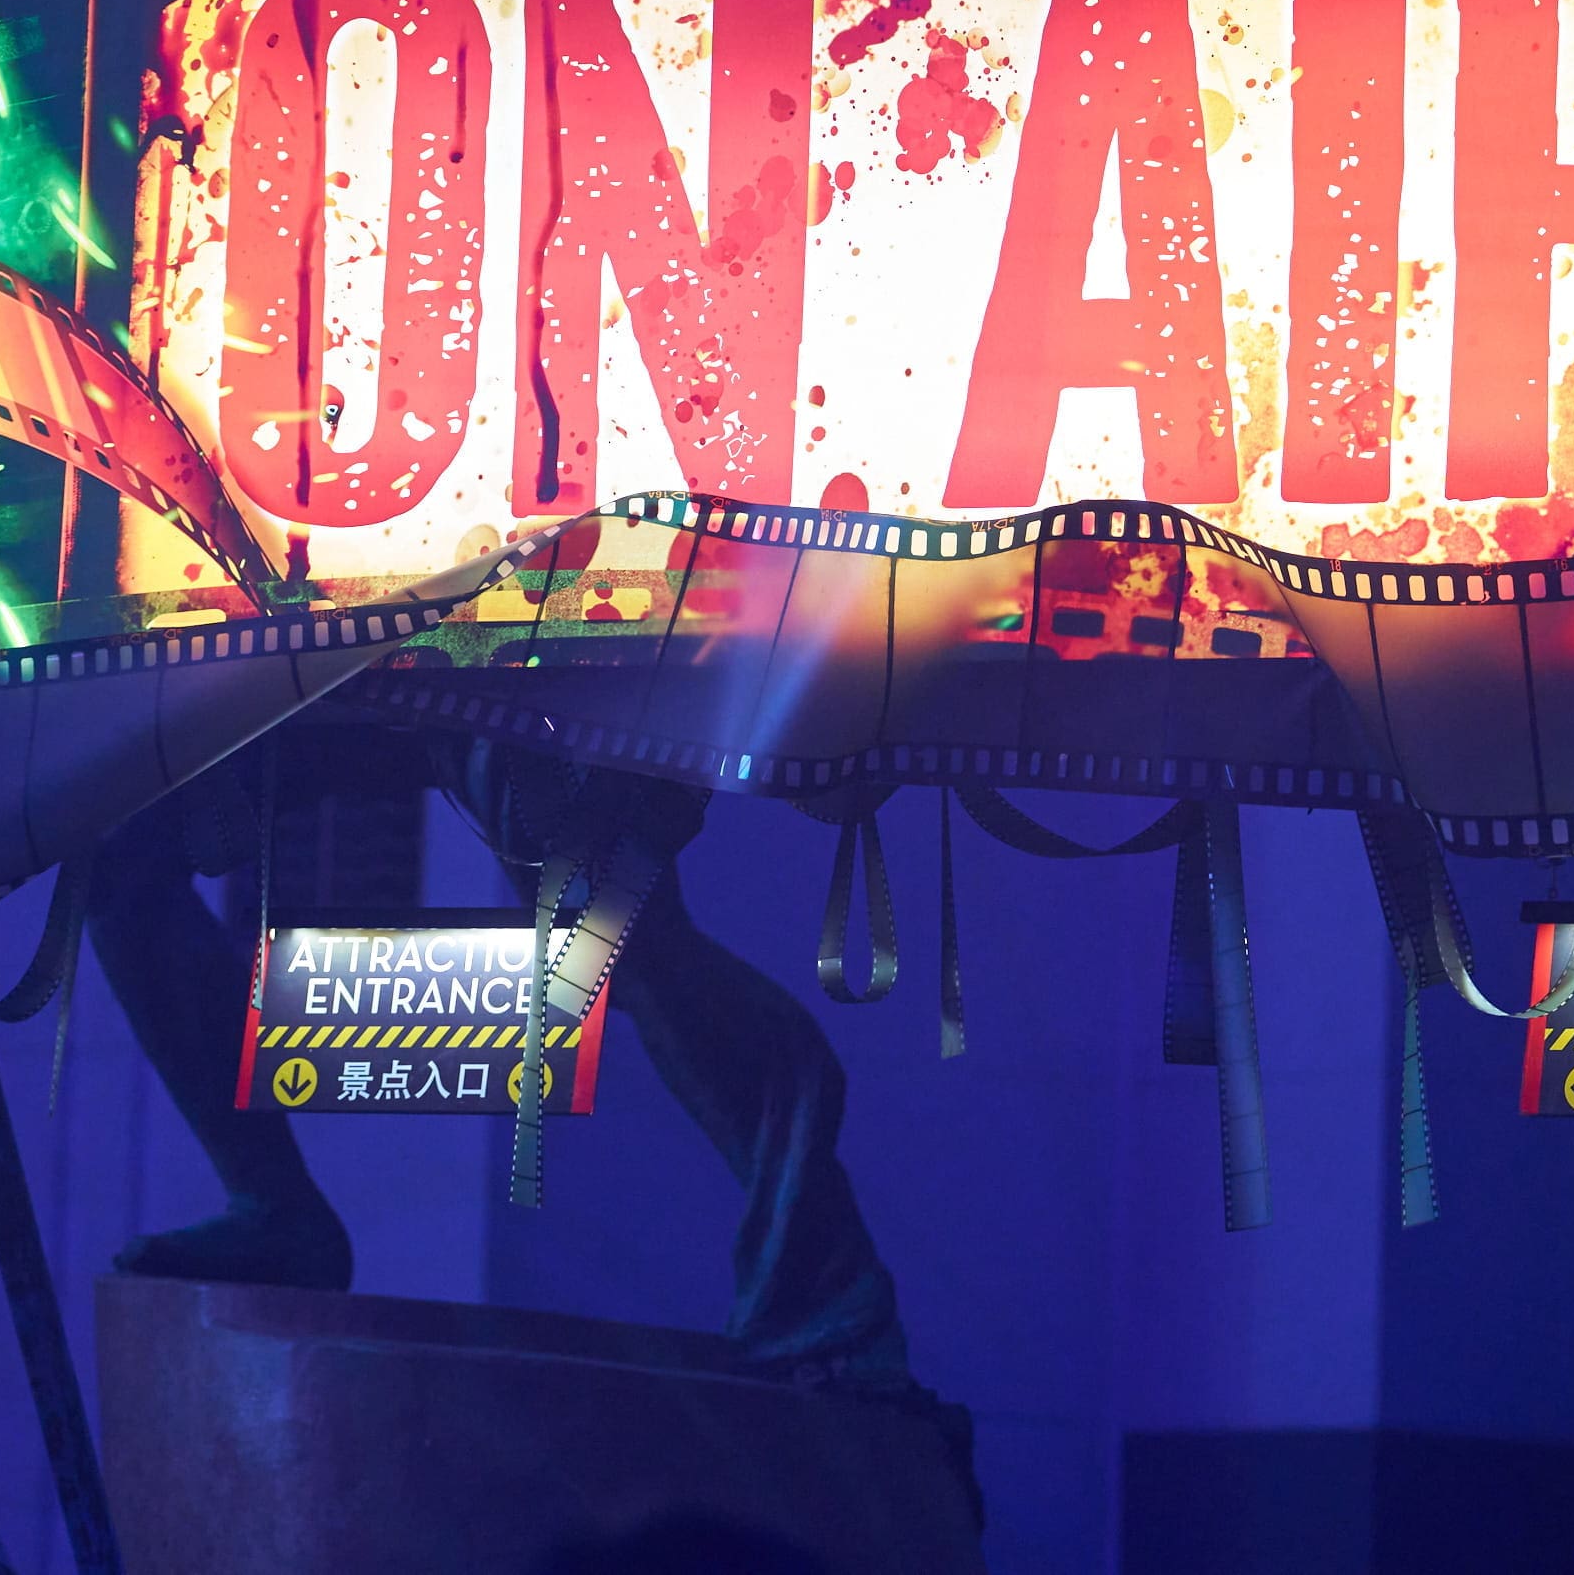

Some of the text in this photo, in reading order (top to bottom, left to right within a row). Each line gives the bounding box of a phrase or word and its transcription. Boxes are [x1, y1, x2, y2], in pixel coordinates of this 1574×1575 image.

[1329, 559, 1342, 572] 18
[287, 936, 533, 973] ATTRACTIO
[336, 1060, 491, 1102] 景点入口
